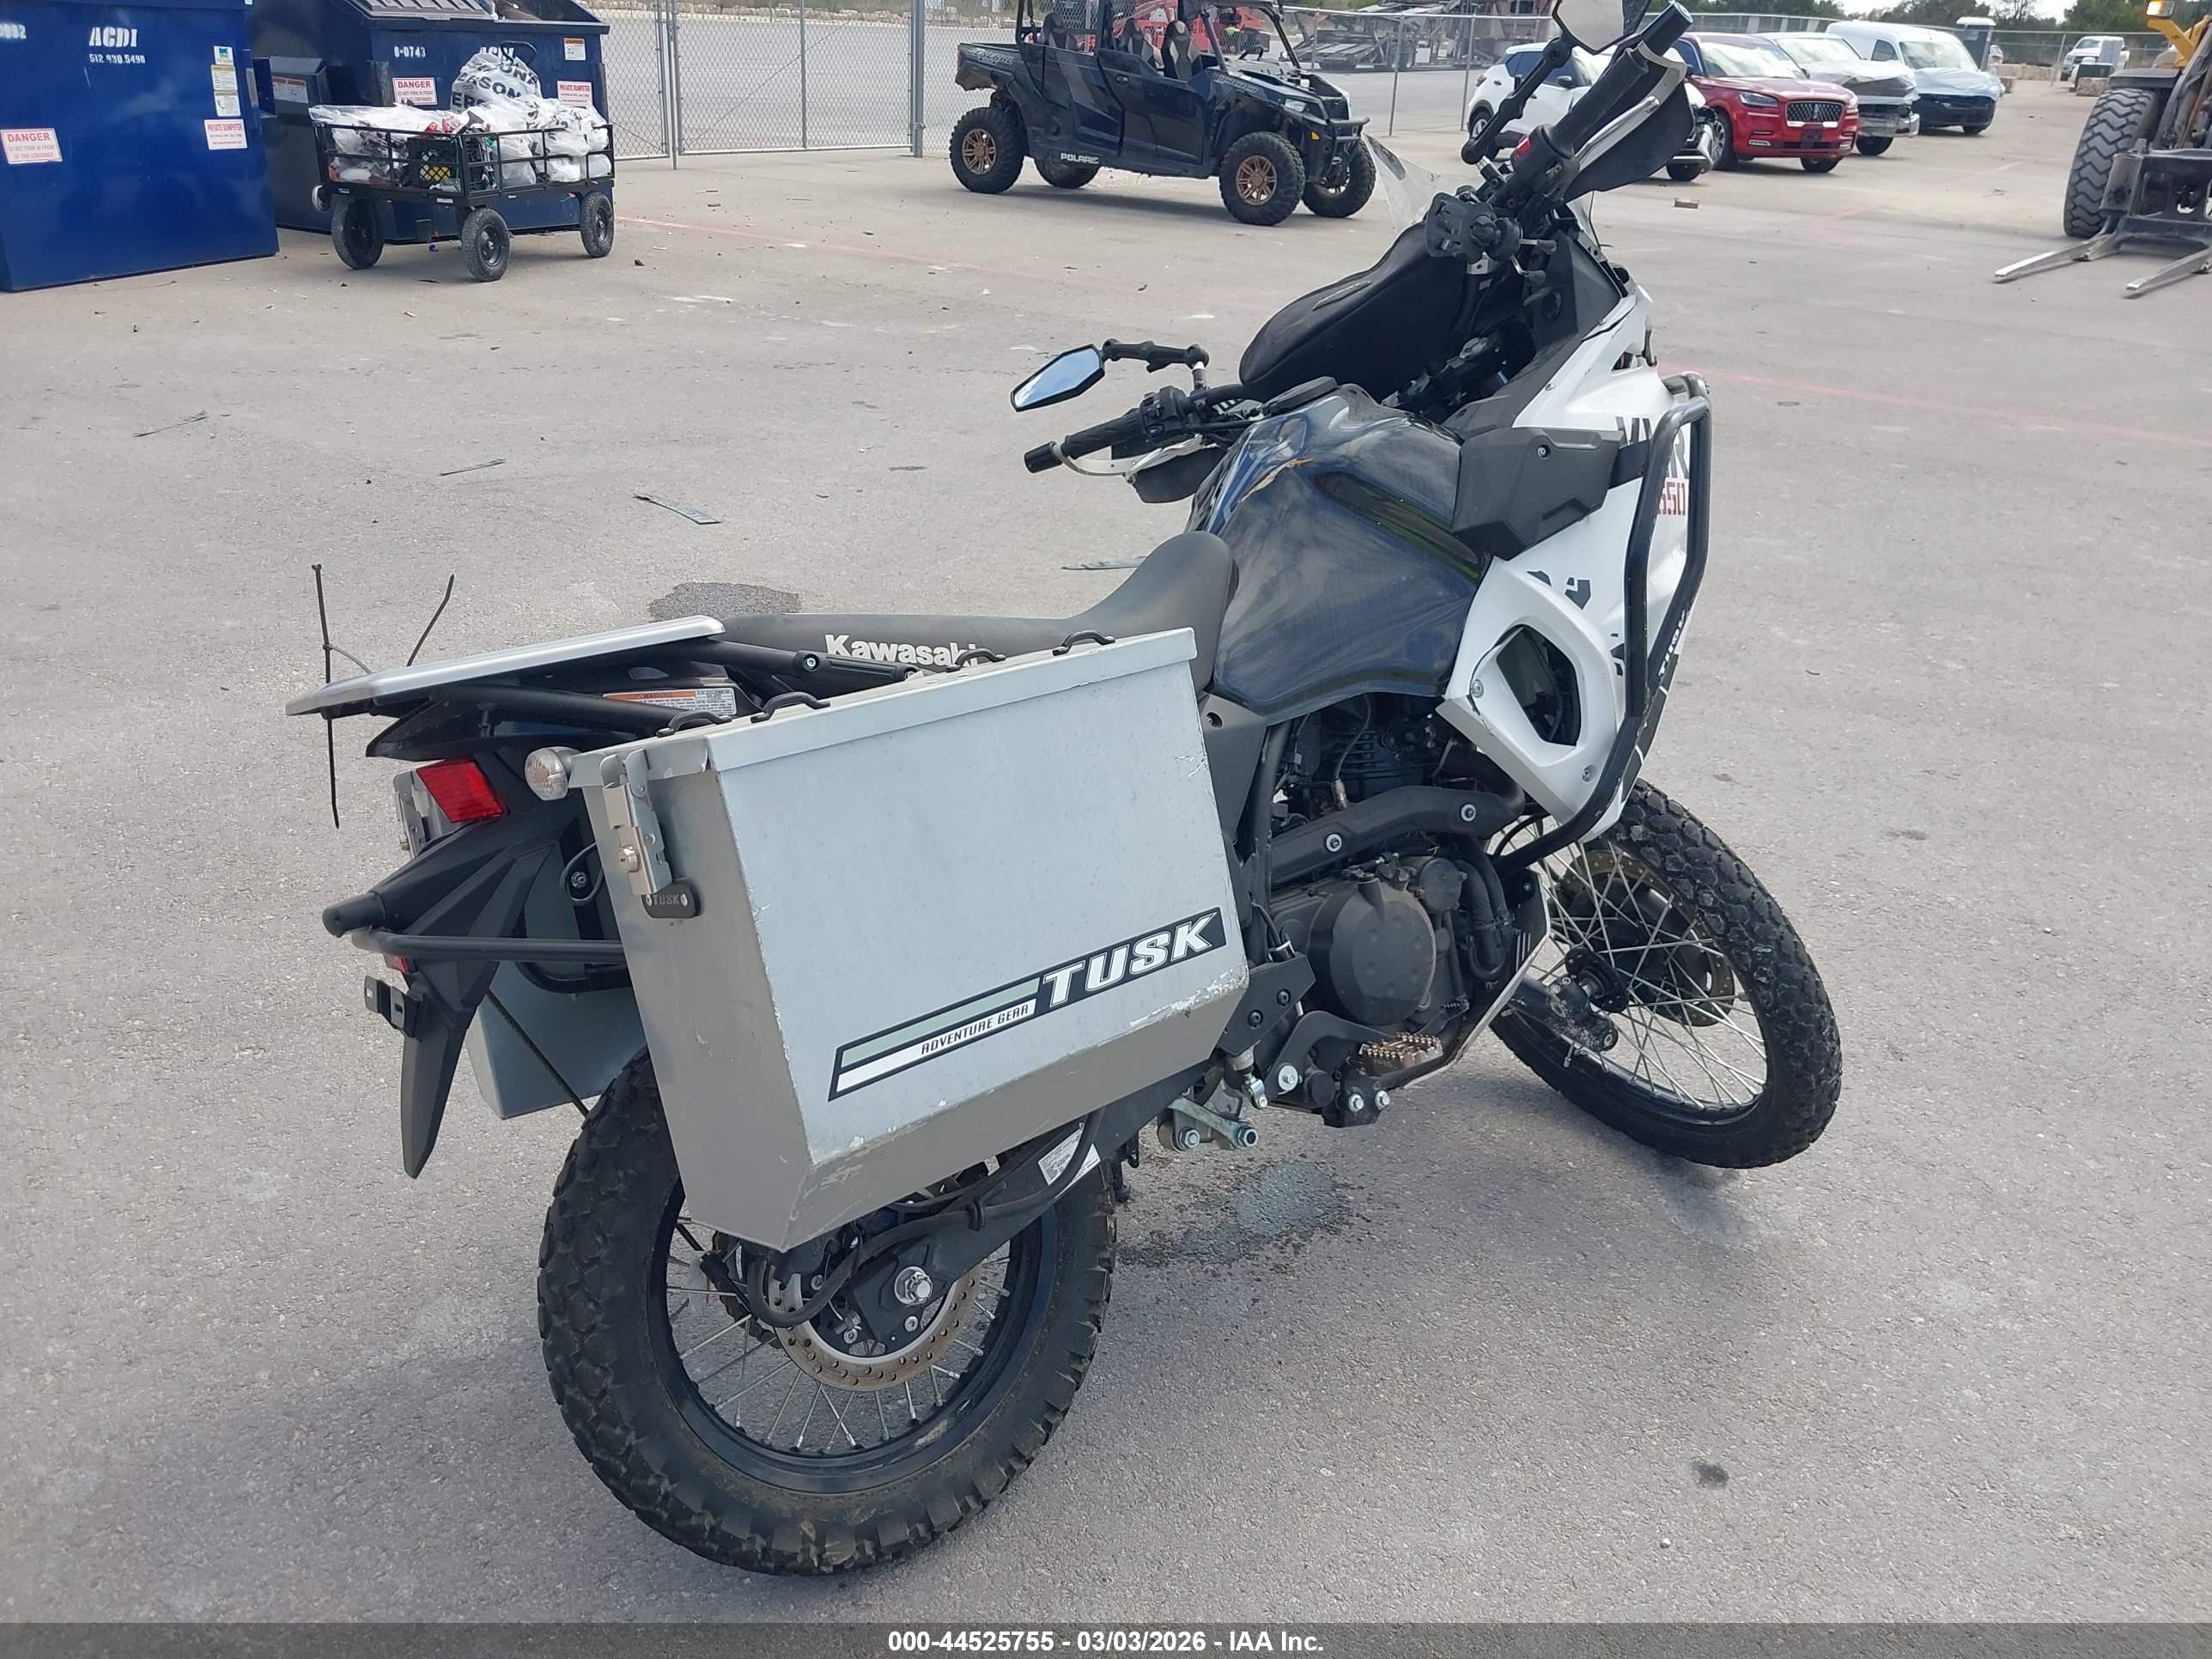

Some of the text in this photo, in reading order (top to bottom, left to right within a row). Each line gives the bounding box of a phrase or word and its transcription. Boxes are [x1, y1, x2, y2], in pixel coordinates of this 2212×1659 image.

[88, 26, 137, 47] ACDI
[88, 53, 104, 64] 512
[7, 132, 51, 143] DANGER
[1060, 152, 1099, 165] POLARIS
[824, 634, 979, 667] Kawasaki
[653, 893, 680, 905] TUSK
[1042, 912, 1217, 1008] TUSK
[921, 1003, 1029, 1054] ADVENTURE GEAR
